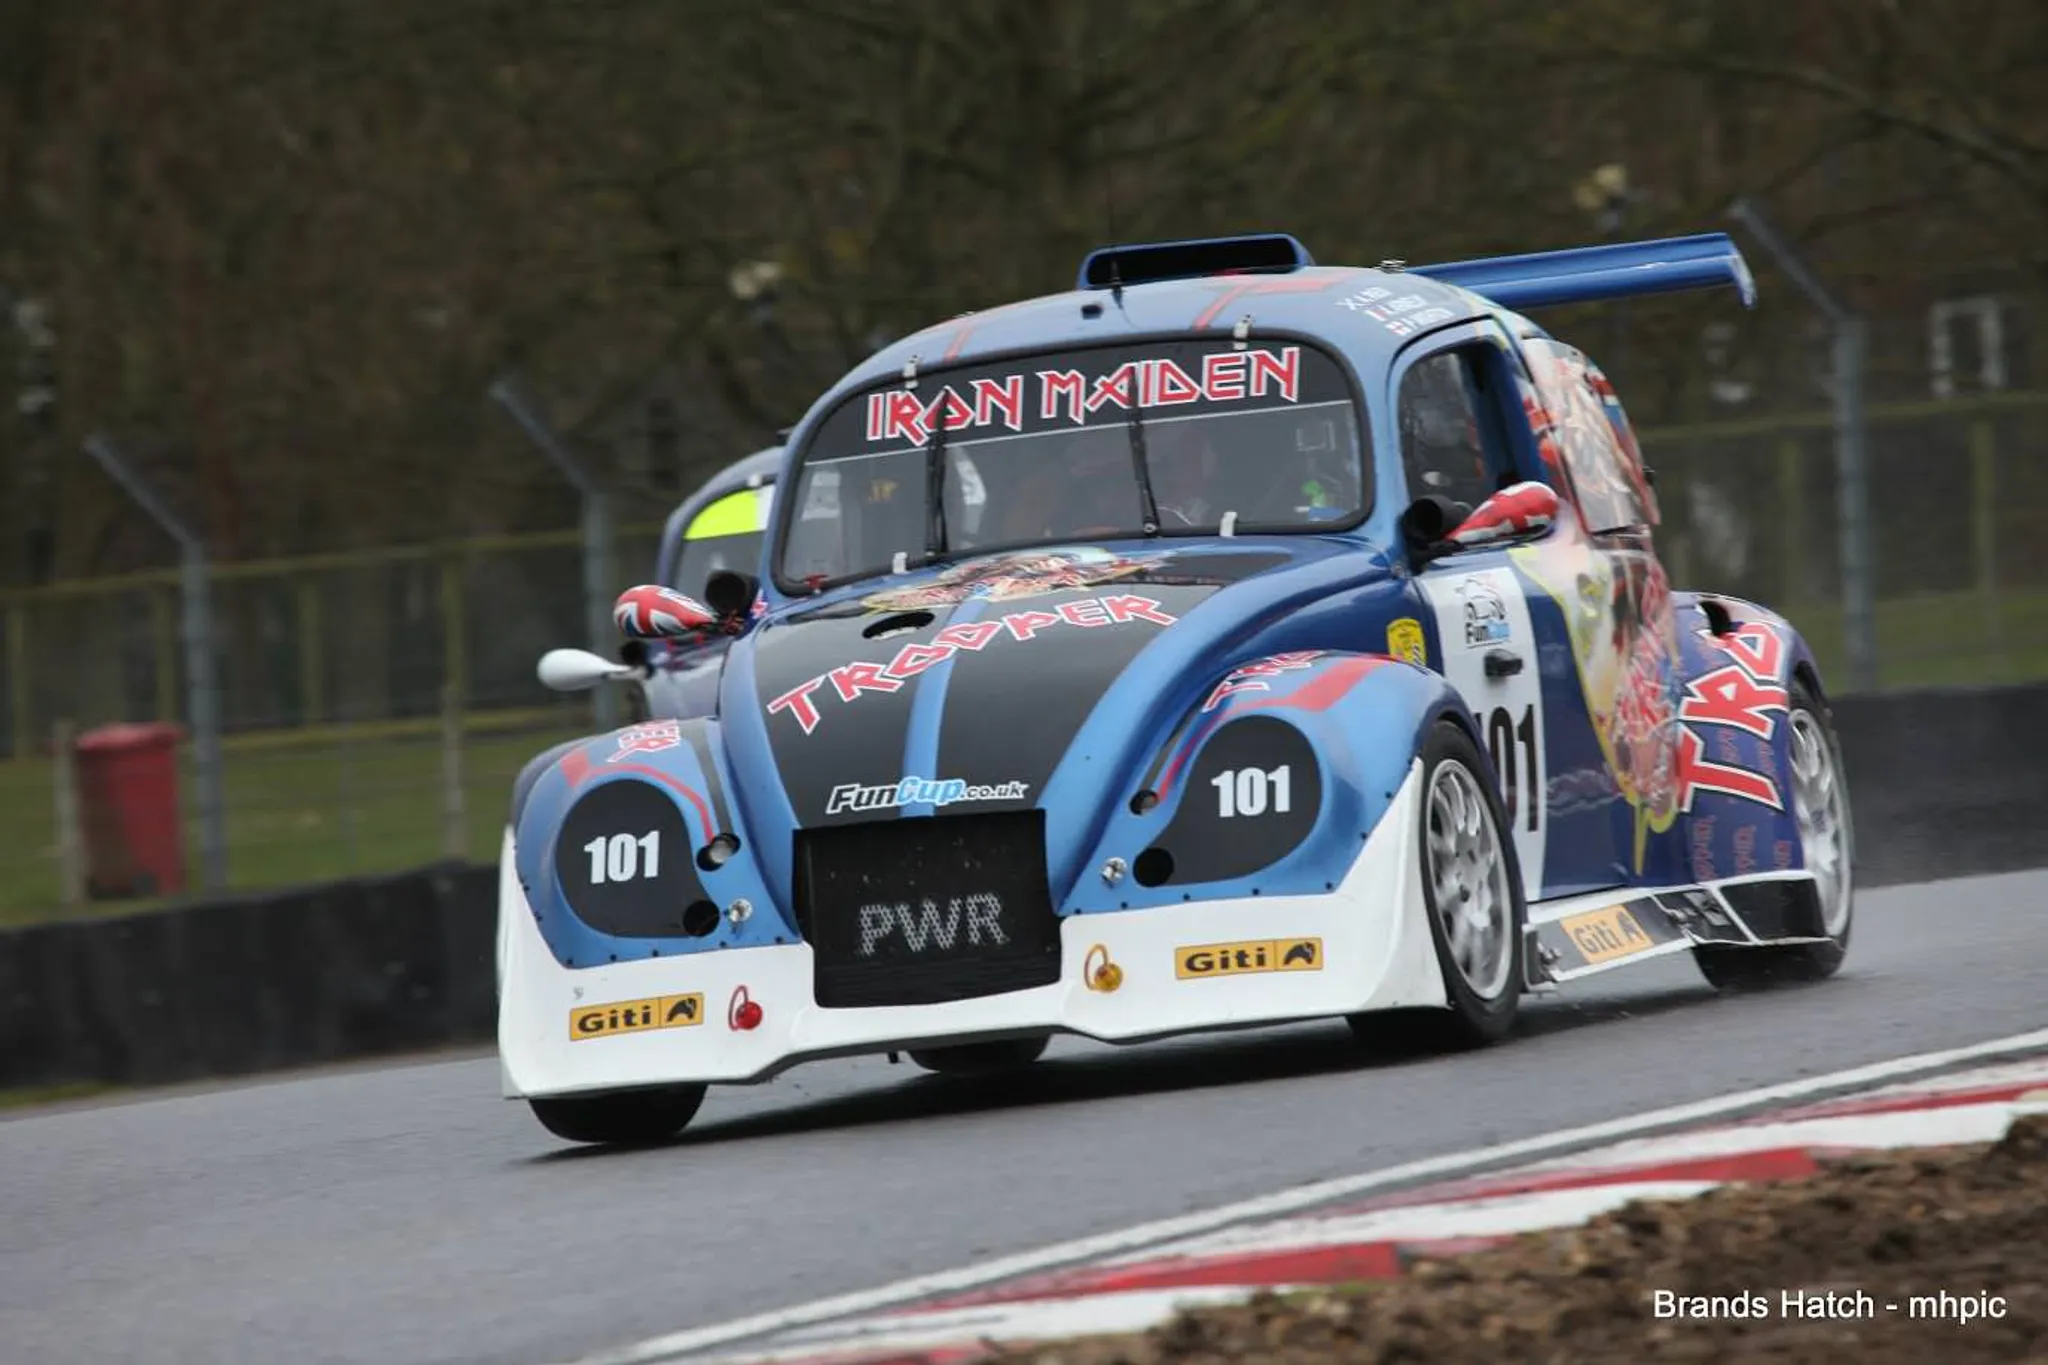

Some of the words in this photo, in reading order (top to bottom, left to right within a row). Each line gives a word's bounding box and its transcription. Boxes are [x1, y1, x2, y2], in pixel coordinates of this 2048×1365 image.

[867, 374, 1024, 447] IRON
[1036, 346, 1300, 426] MAIDEN
[767, 594, 1179, 735] TROOPER
[826, 776, 1029, 814] FunCup.co.uk
[1211, 765, 1291, 817] 101
[1474, 704, 1538, 832] 01
[583, 830, 660, 884] 101
[857, 892, 1007, 957] PWR
[1185, 946, 1267, 974] Giti
[577, 1005, 651, 1033] Giti
